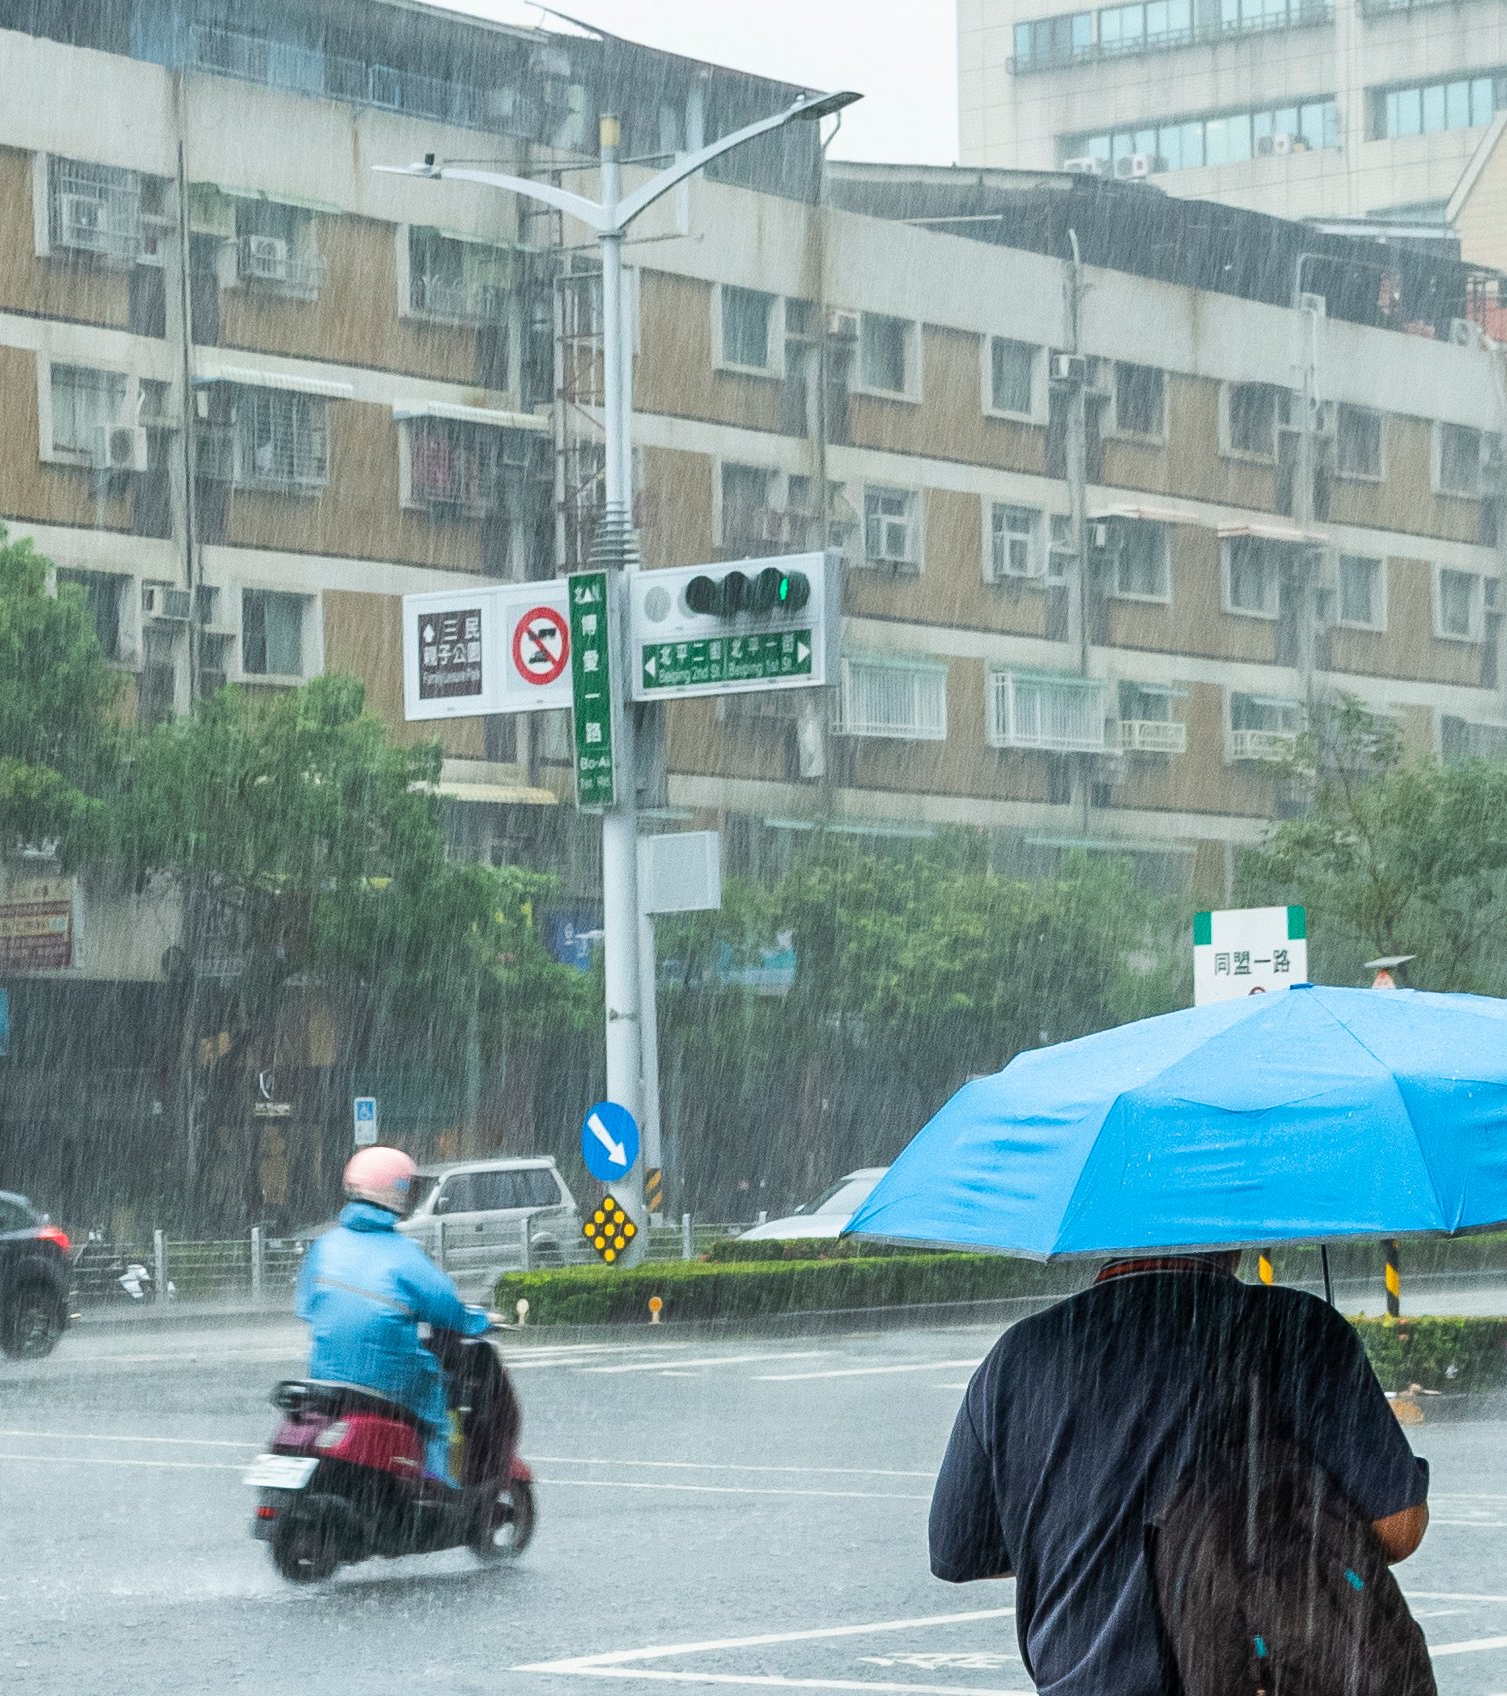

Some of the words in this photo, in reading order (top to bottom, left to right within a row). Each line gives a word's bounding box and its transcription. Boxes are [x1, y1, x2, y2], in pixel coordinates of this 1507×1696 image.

[443, 617, 480, 640] 三民
[1214, 949, 1291, 977] 同盟一路
